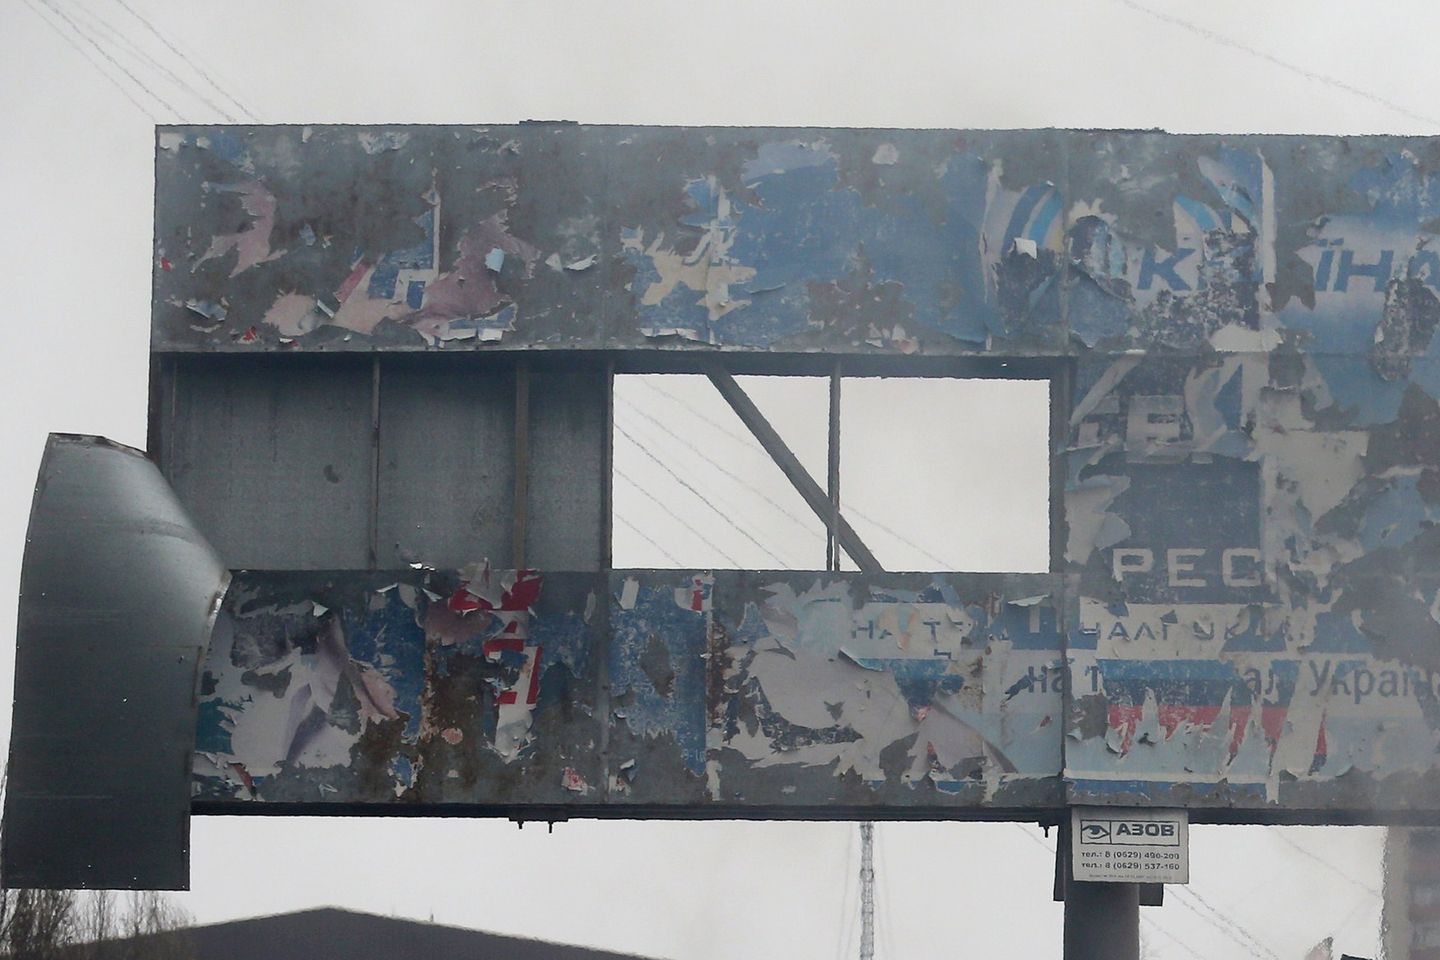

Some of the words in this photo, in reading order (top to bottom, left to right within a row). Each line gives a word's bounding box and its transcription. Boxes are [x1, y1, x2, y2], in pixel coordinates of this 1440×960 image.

[1116, 823, 1174, 836] АЗОВ
[1113, 851, 1141, 859] (0629)
[1113, 861, 1141, 869] (0629)
